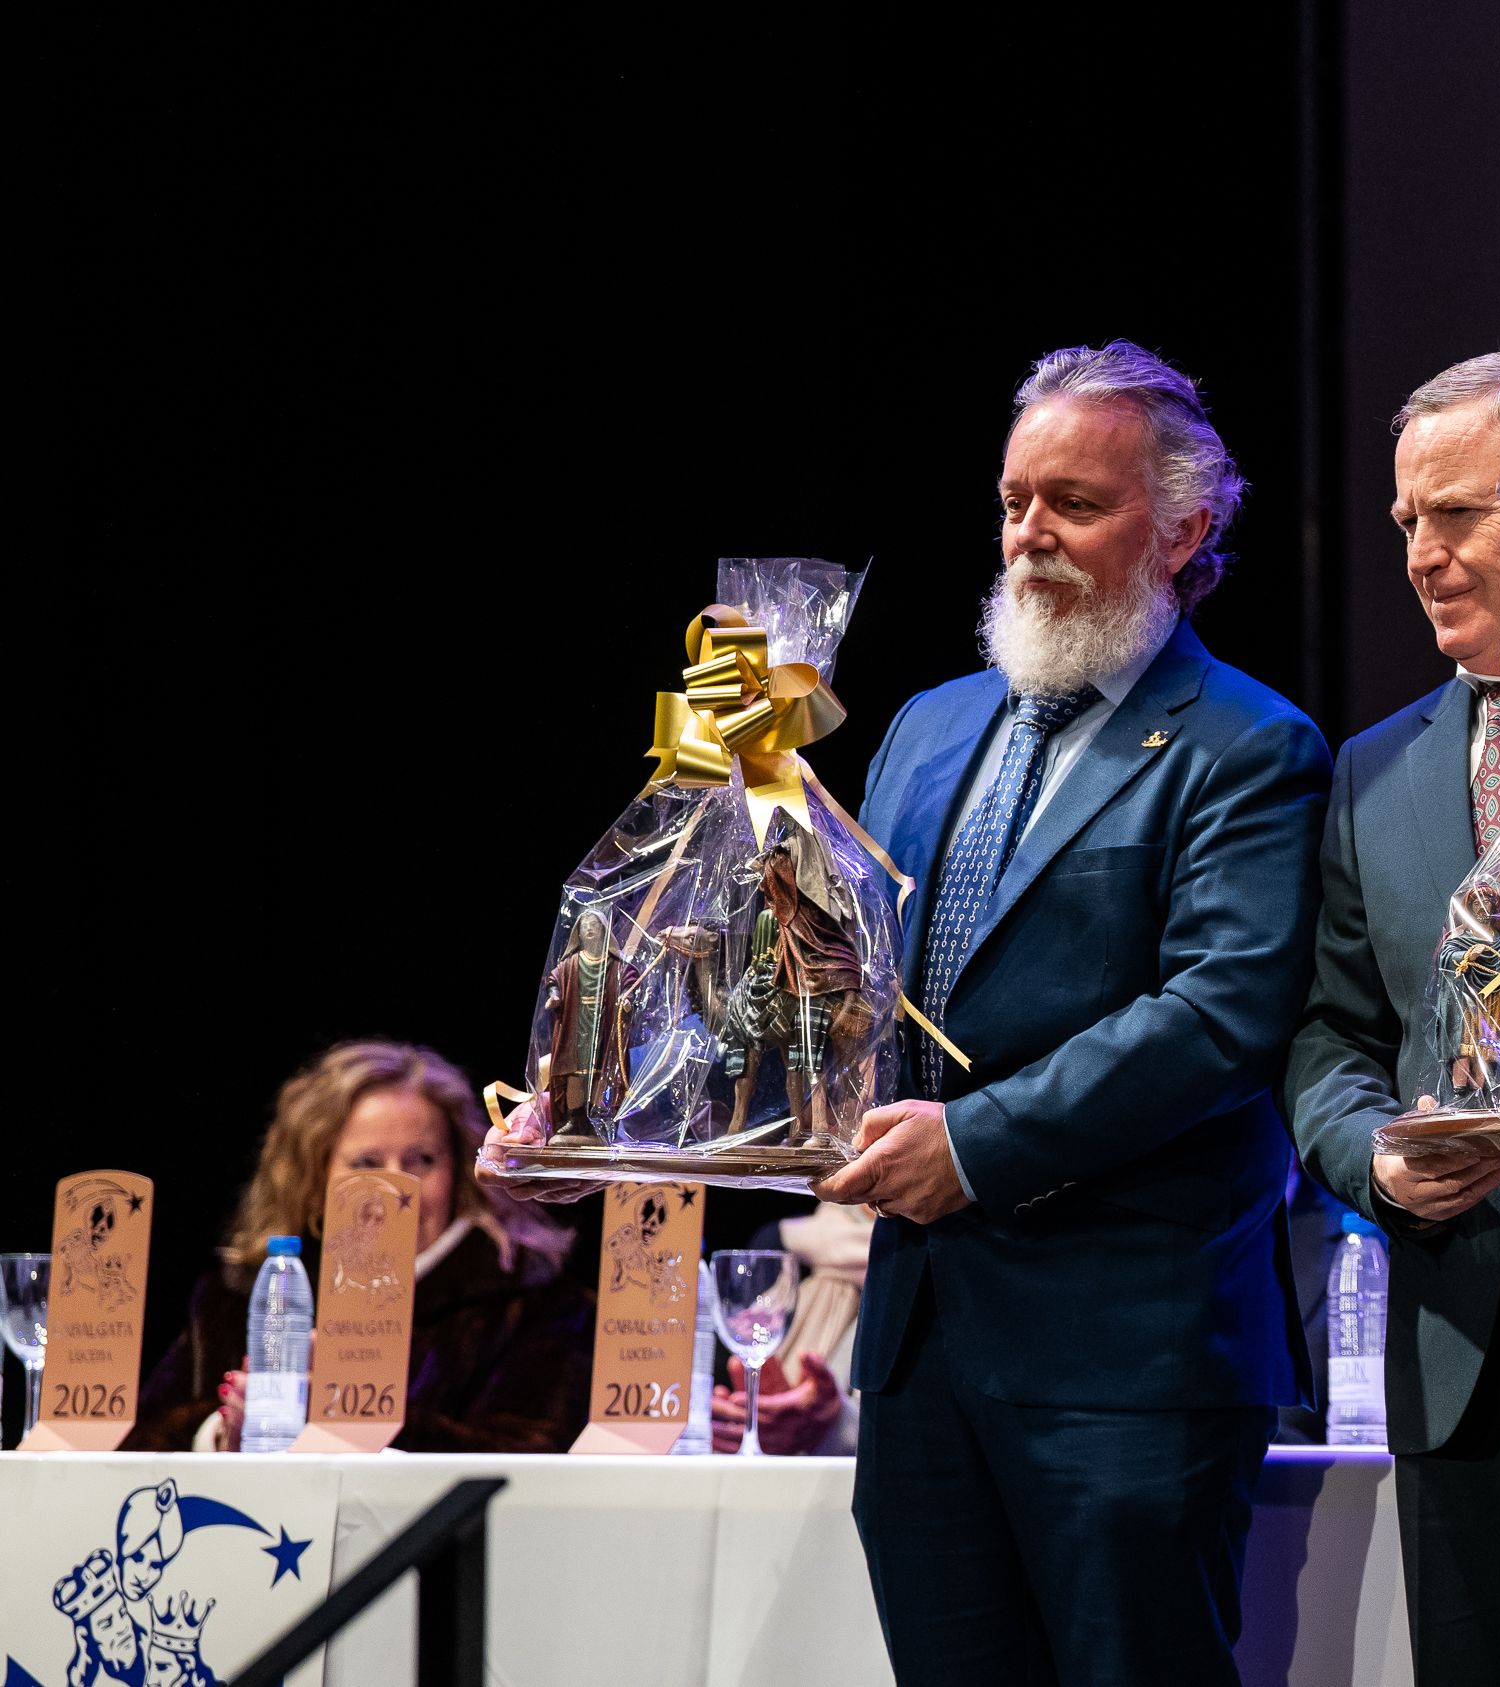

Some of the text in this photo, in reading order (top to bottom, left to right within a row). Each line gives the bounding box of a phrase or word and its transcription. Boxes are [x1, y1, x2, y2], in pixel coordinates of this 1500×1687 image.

[53, 1383, 127, 1417] 2026
[322, 1382, 396, 1417] 2026
[604, 1382, 681, 1417] 2026
